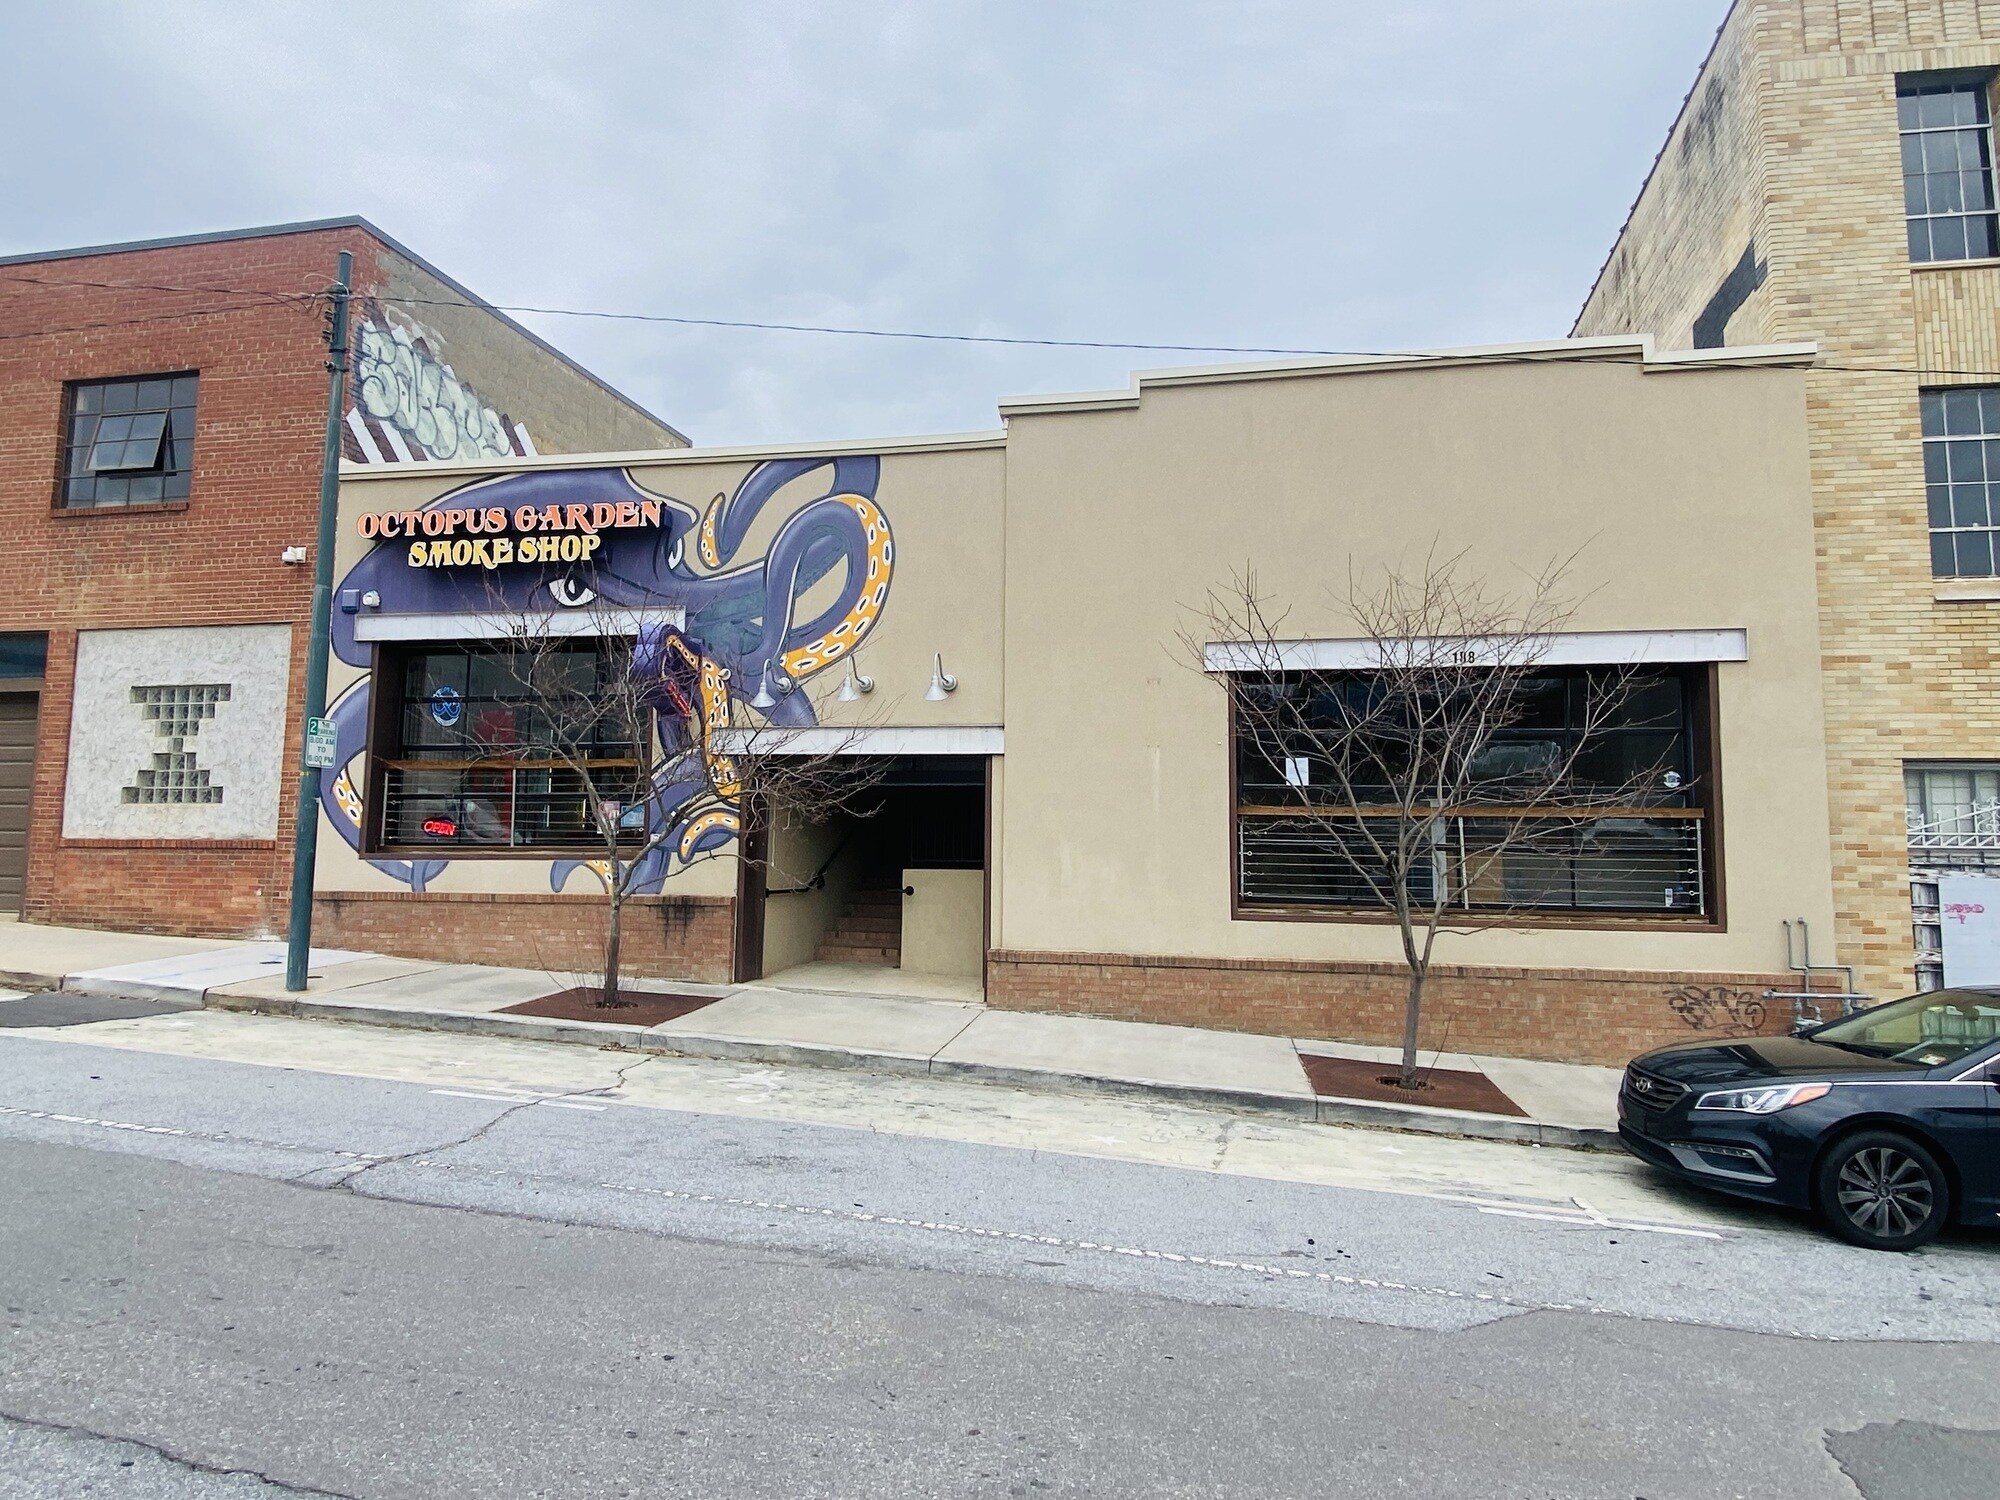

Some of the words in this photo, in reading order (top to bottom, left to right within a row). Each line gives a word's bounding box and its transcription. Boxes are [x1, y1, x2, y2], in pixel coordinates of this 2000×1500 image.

[356, 506, 507, 539] OCTOPUS
[514, 500, 663, 534] GARDEN
[408, 538, 513, 569] SMOKE
[517, 535, 601, 563] SHOP
[310, 721, 317, 733] 2
[424, 821, 456, 835] OPEN
